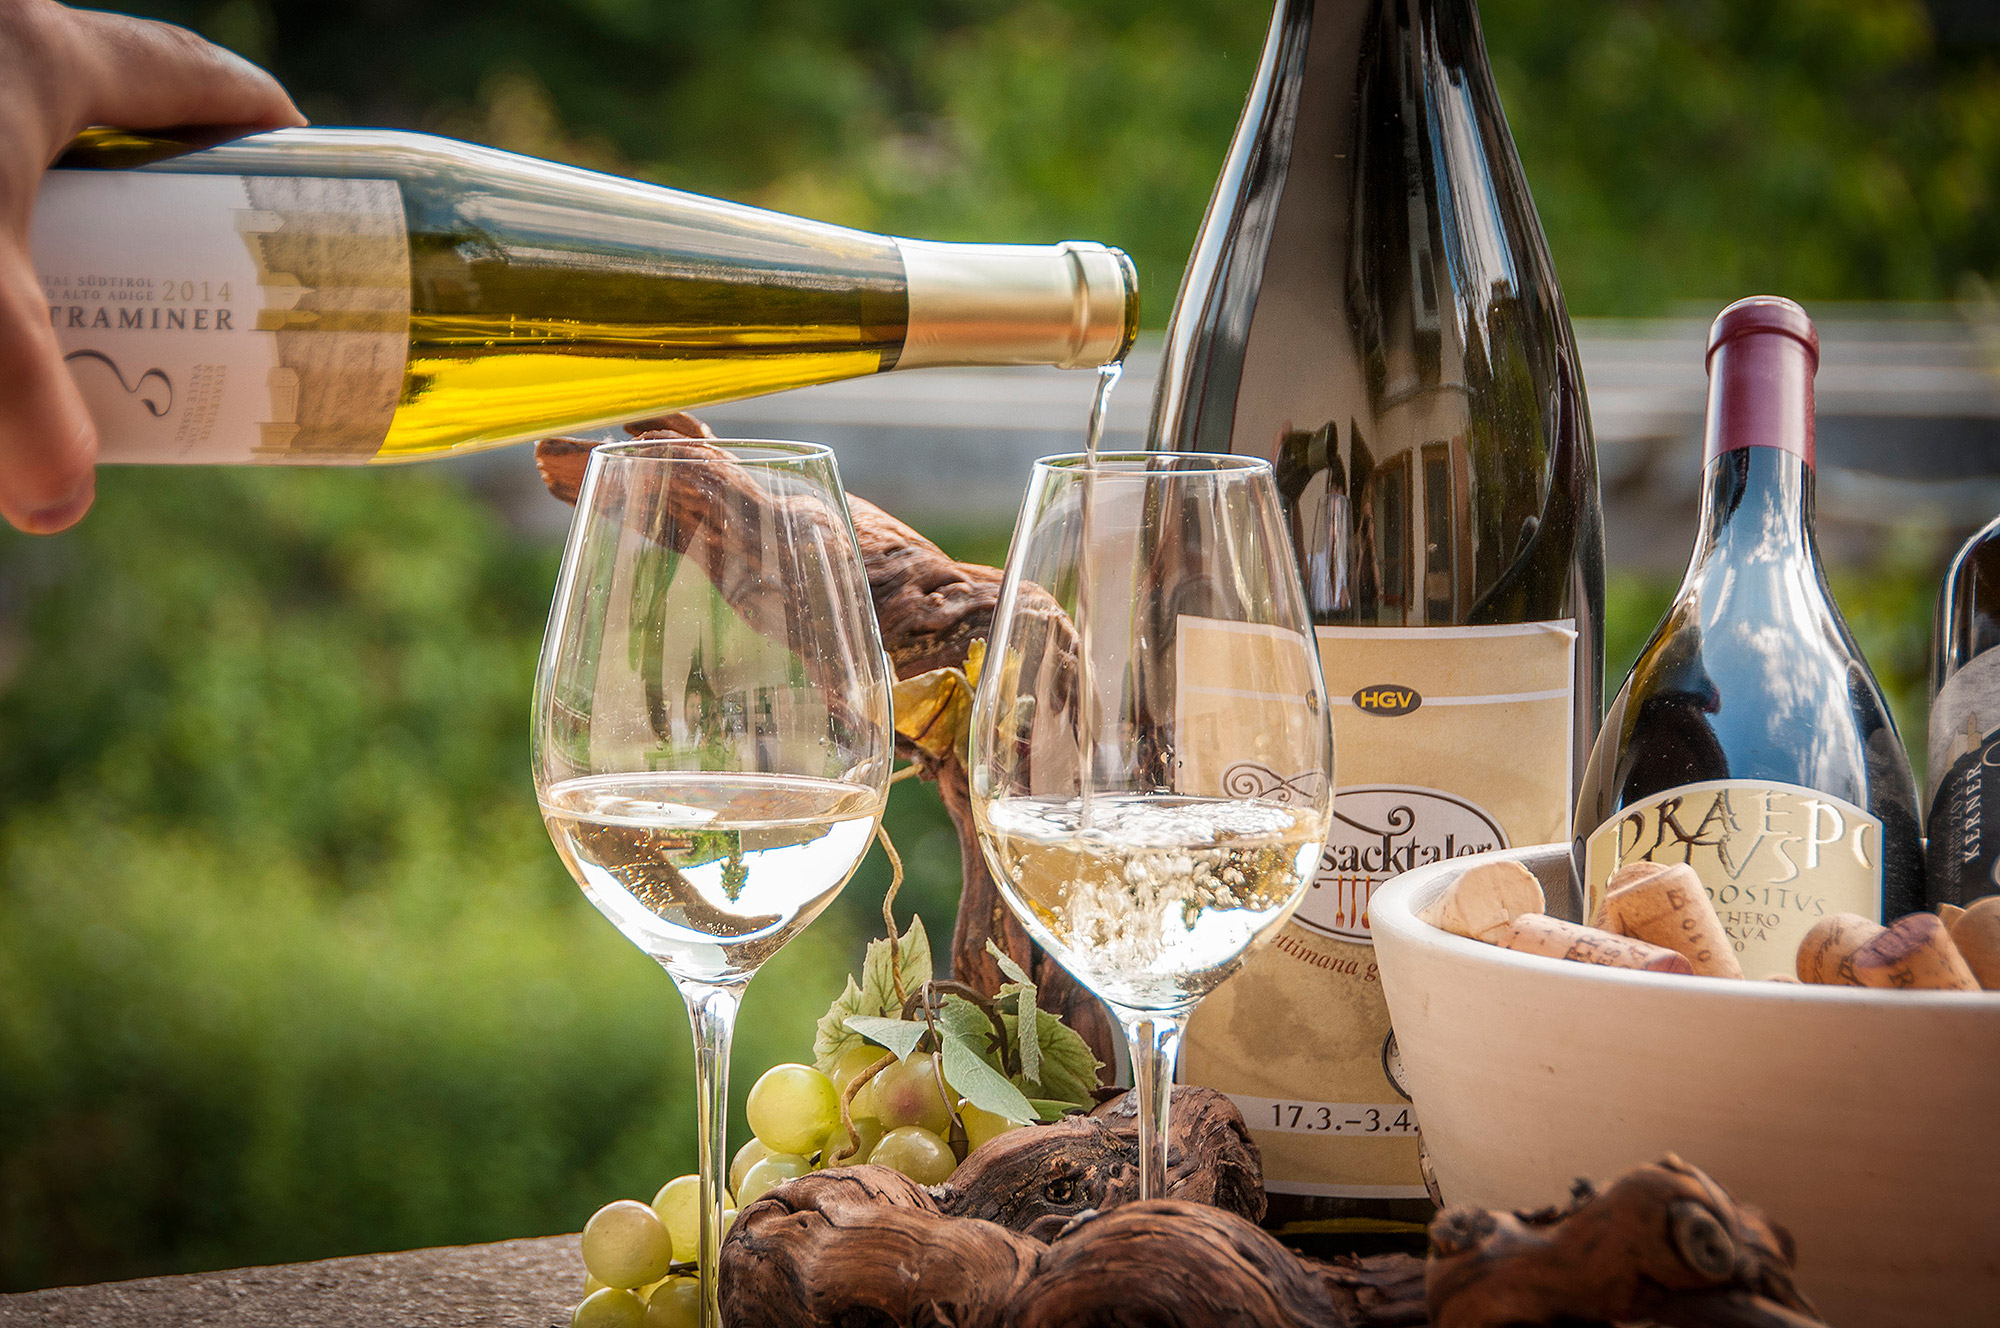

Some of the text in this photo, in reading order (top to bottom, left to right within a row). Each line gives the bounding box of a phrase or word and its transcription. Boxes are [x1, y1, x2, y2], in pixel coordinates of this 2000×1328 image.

[78, 274, 154, 288] SÜDTIROL
[162, 279, 233, 303] 2014
[62, 289, 101, 301] ALTO
[107, 290, 154, 301] ADIGE
[47, 305, 234, 331] TRAMINER
[1360, 691, 1413, 708] HGV
[1950, 776, 1964, 826] 2013
[1964, 761, 1983, 864] KERNER
